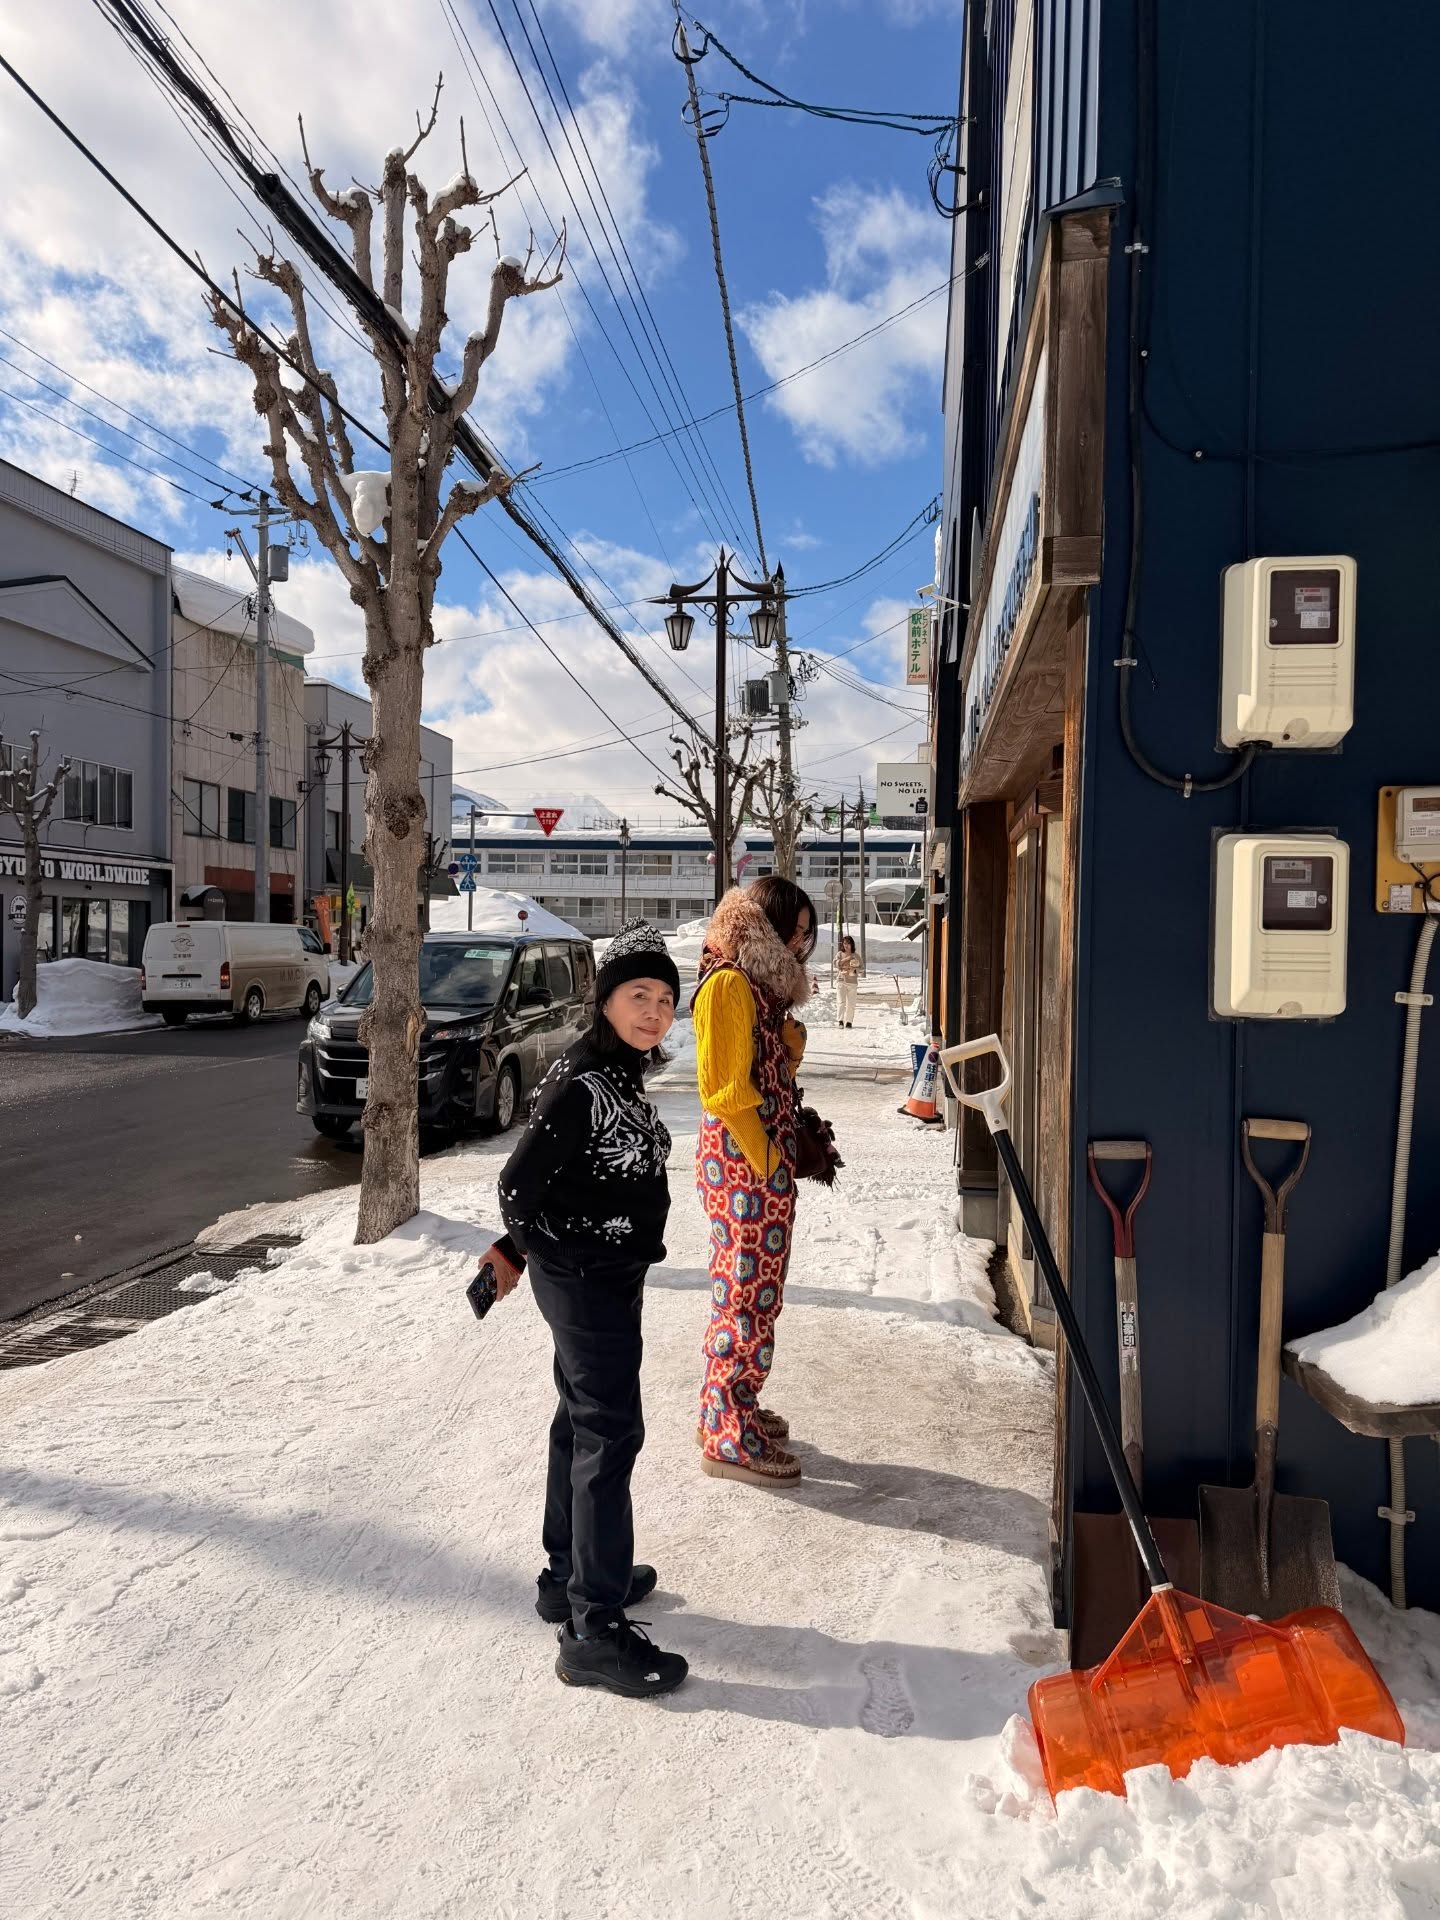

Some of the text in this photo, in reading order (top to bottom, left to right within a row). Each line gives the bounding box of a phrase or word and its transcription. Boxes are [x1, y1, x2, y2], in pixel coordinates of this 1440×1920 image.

[911, 613, 922, 673] 駅前ホテル
[60, 861, 150, 886] WORLDWIDE
